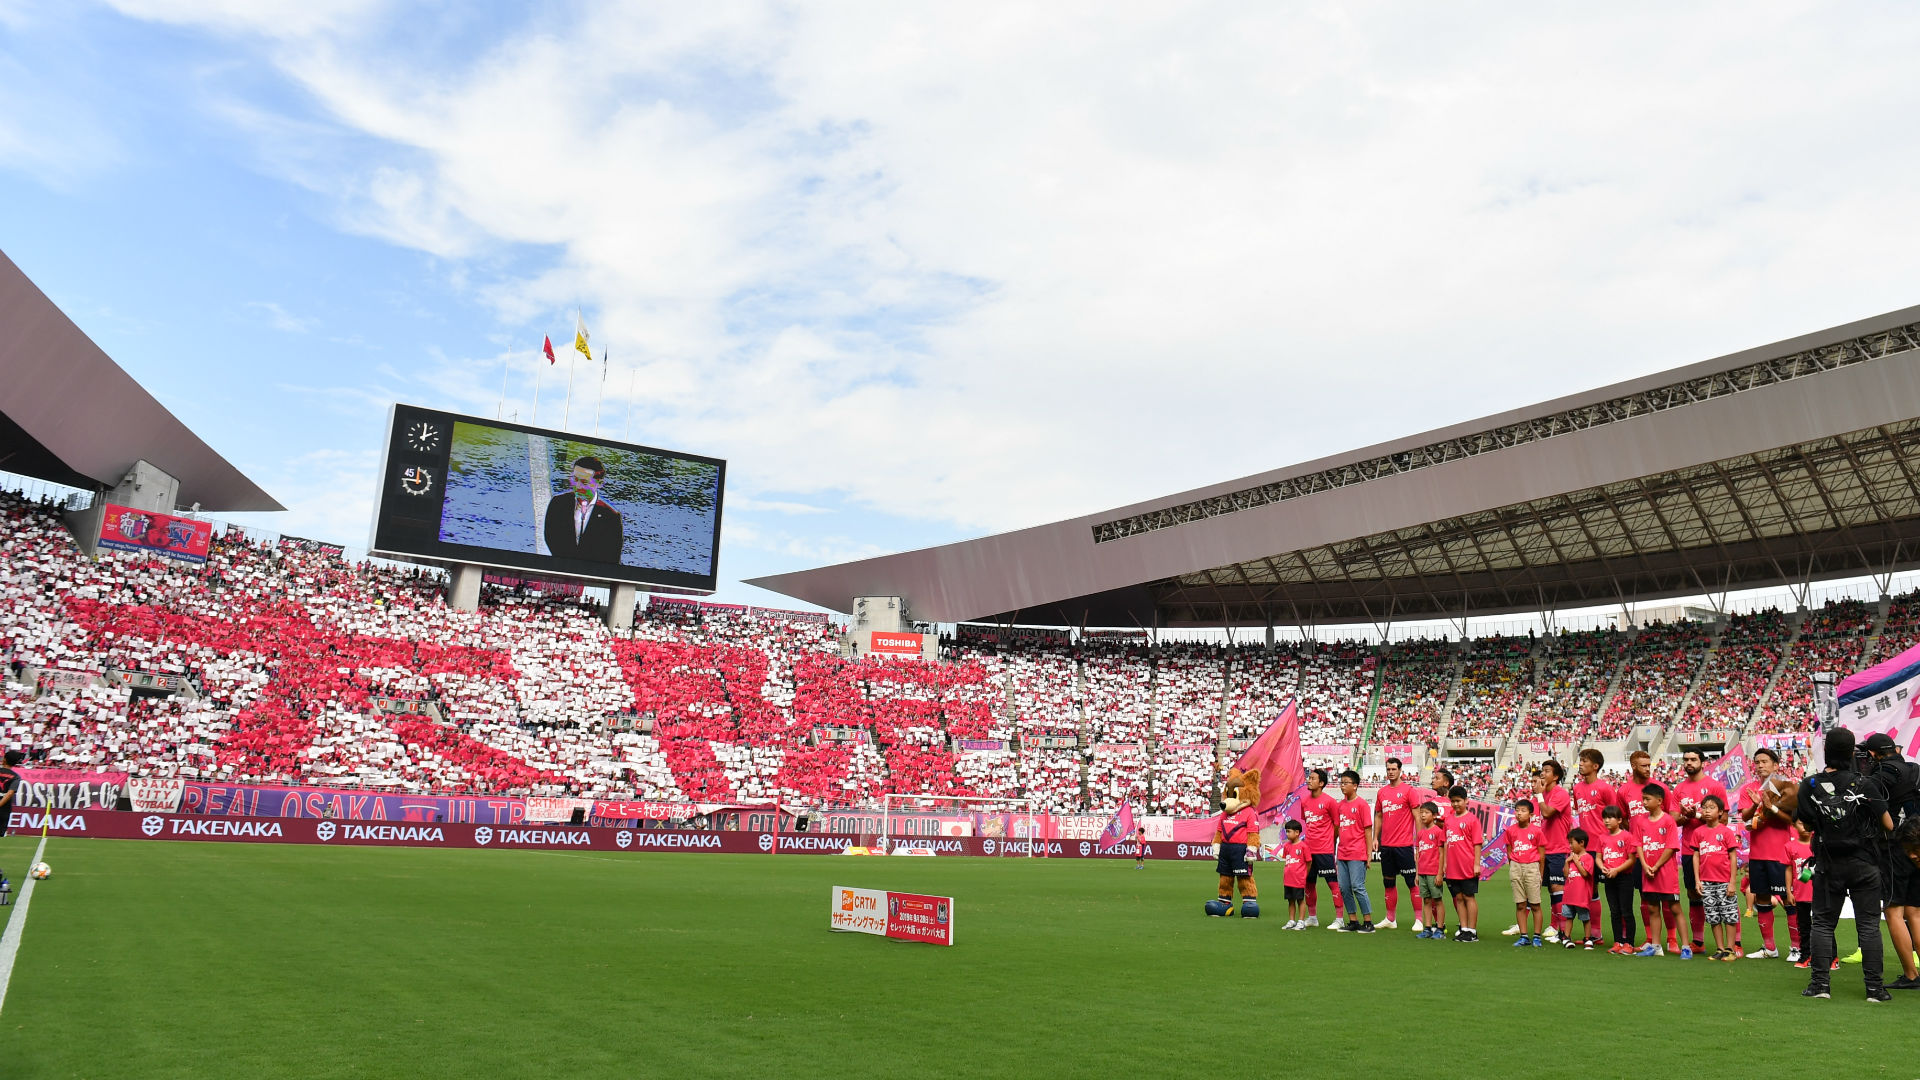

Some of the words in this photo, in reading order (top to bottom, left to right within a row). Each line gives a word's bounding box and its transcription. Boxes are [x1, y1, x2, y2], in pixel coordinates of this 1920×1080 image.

[404, 468, 415, 477] 45
[877, 638, 917, 648] TOSHIBA
[1687, 733, 1695, 742] H
[1717, 732, 1725, 740] 2
[1456, 740, 1464, 748] H
[130, 779, 179, 790] OSAKA
[16, 780, 119, 810] OSAKA-06
[138, 789, 171, 800] CITY
[134, 799, 174, 809] OOTBALL
[181, 786, 259, 815] REAL
[281, 792, 388, 820] OSAKA
[8, 812, 87, 831] ENAKA
[749, 813, 791, 833] CITY
[904, 818, 941, 836] CLUB
[1058, 816, 1095, 829] NEVER
[169, 819, 283, 838] TAKENAKA
[341, 823, 444, 842] TAKENAKA
[1058, 828, 1095, 840] NEVER
[498, 829, 591, 846] TAKENAKA
[636, 833, 722, 848] TAKENAKA
[776, 836, 854, 850] TAKENAKA
[893, 839, 963, 852] TAKENAKA
[998, 841, 1063, 855] TAKENAKA
[854, 895, 877, 911] CRTM
[832, 911, 886, 932] サポーティングマッチ
[922, 926, 946, 939] ガンバ大阪
